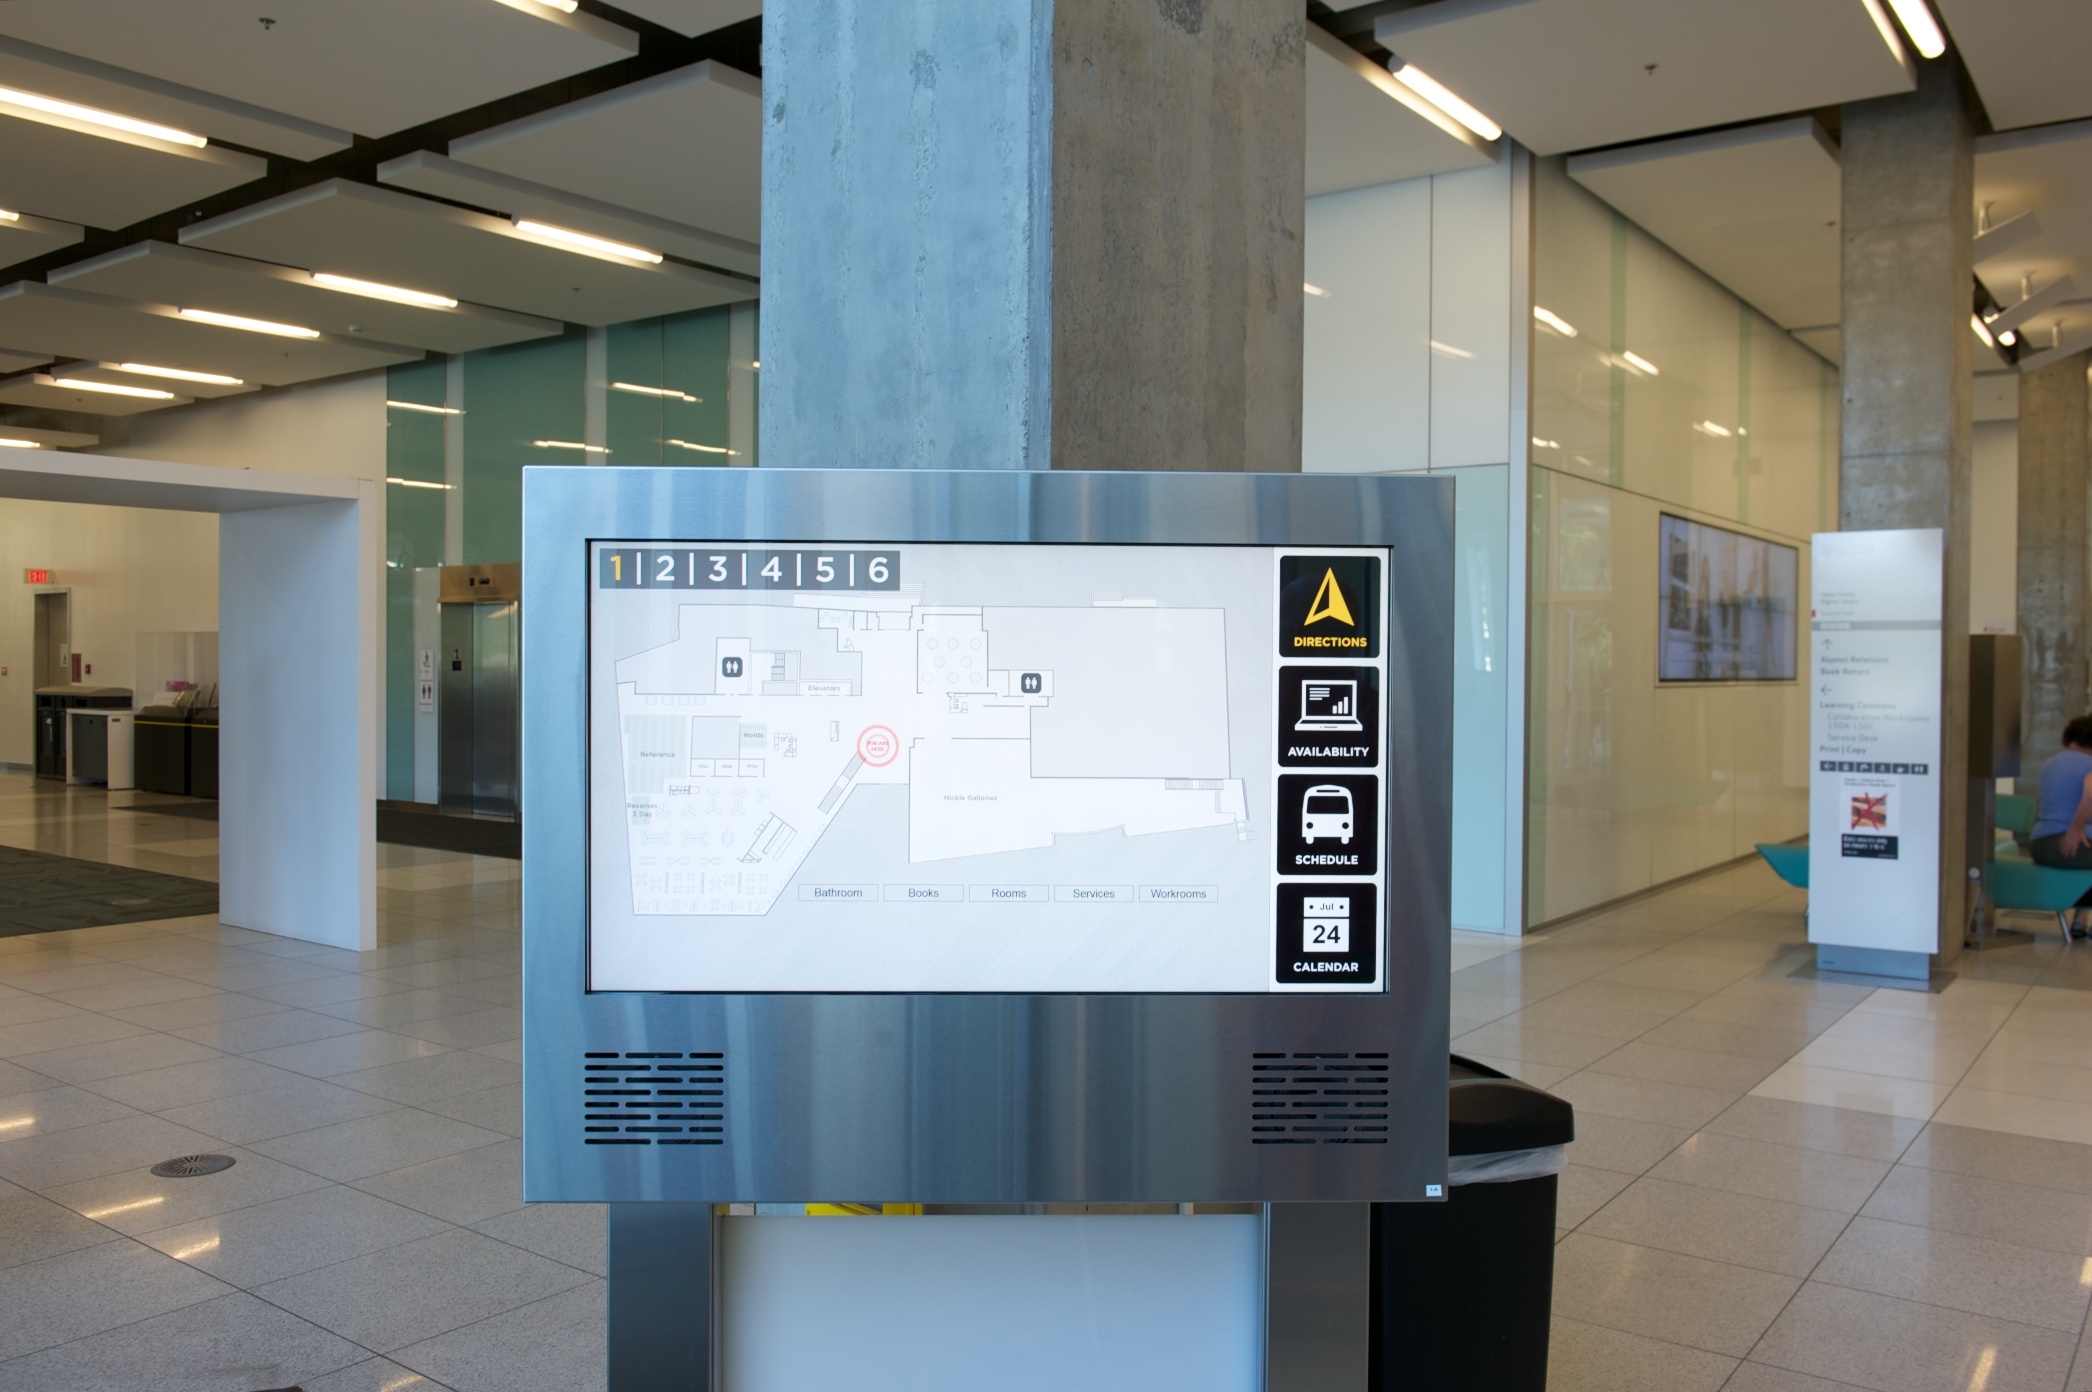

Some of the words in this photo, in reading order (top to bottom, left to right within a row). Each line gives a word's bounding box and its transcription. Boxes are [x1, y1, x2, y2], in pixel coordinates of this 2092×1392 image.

[610, 555, 622, 581] 1
[656, 555, 675, 581] 2
[708, 555, 728, 582] 3
[760, 556, 783, 582] 4
[815, 556, 835, 583] 5
[868, 556, 889, 584] 6
[1294, 636, 1368, 647] DIRECTIONS
[808, 684, 841, 692] Elevators
[1820, 702, 1855, 710] Learning
[743, 731, 764, 739] Holds
[1858, 734, 1878, 742] Desk
[1288, 747, 1369, 757] AVAILABILITY
[1846, 746, 1867, 755] Copy
[632, 810, 637, 818] 3
[639, 810, 653, 818] Day
[1295, 855, 1359, 865] SCHEDULE
[814, 887, 863, 898] Bathroom
[908, 888, 940, 898] Books
[991, 888, 1027, 899] Rooms
[1073, 888, 1116, 899] Services
[1151, 889, 1207, 899] Workrooms
[1319, 903, 1334, 911] Jul
[1313, 924, 1341, 944] 24
[1293, 962, 1359, 972] CALENDAR
